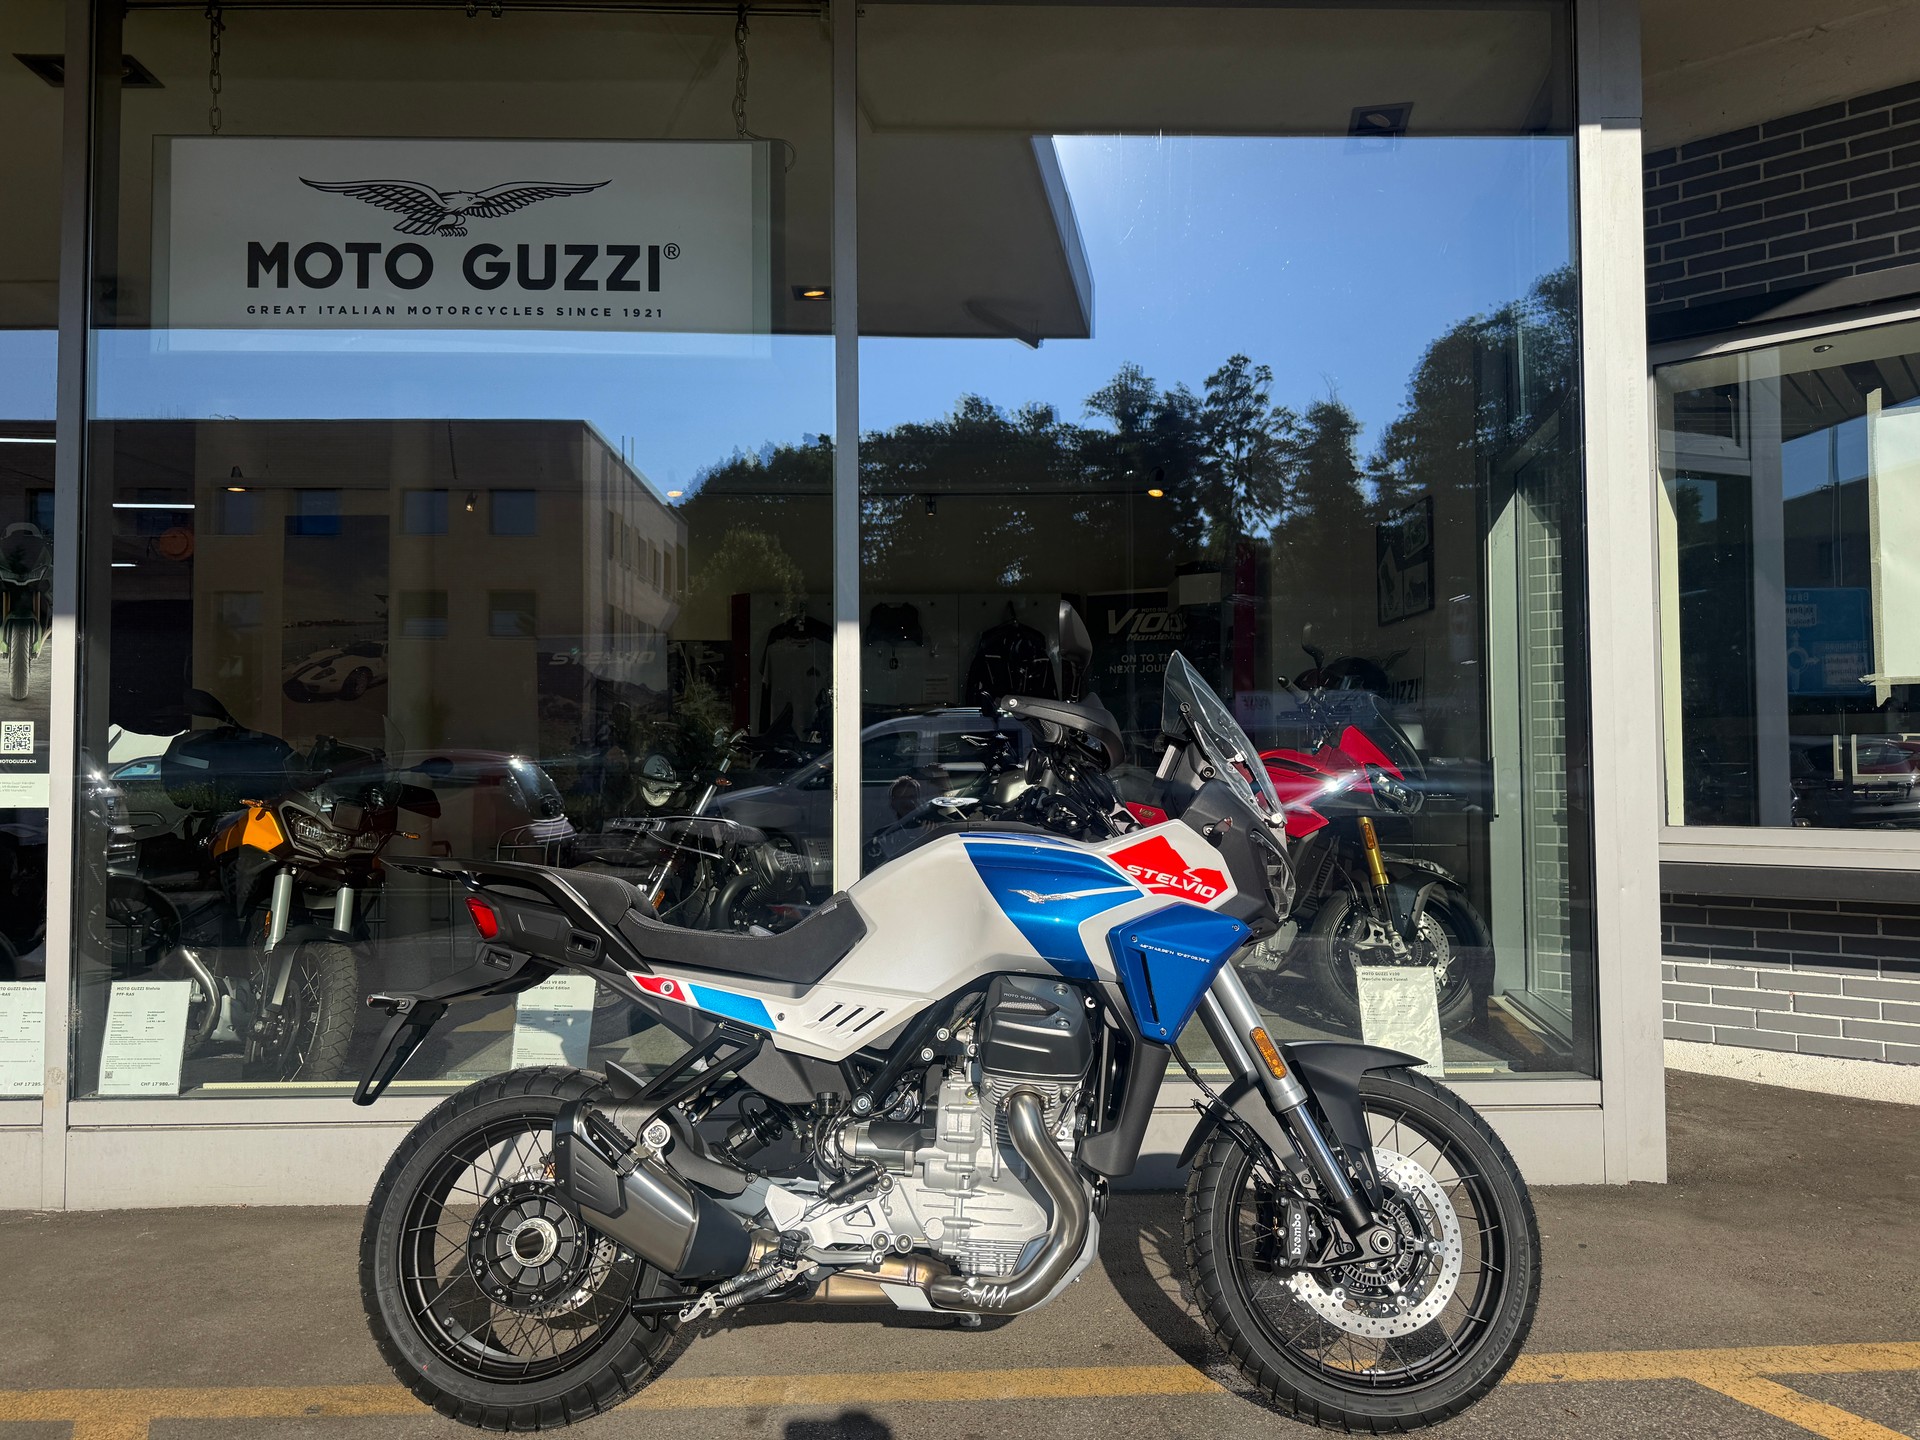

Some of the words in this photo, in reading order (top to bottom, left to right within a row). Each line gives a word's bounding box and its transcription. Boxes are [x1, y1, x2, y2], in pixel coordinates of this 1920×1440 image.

[247, 242, 434, 290] MOTO
[246, 305, 307, 315] GREAT
[318, 305, 397, 315] ITALIAN
[407, 305, 546, 316] MOTORCYCLES
[556, 306, 613, 317] SINCE
[623, 307, 664, 318] 1921
[1109, 664, 1137, 675] NEXT
[1120, 654, 1137, 663] ON
[1139, 653, 1155, 663] TO
[1126, 864, 1218, 899] STELVIO
[1291, 1213, 1302, 1255] brembo
[1508, 1253, 1527, 1321] MICHELIN
